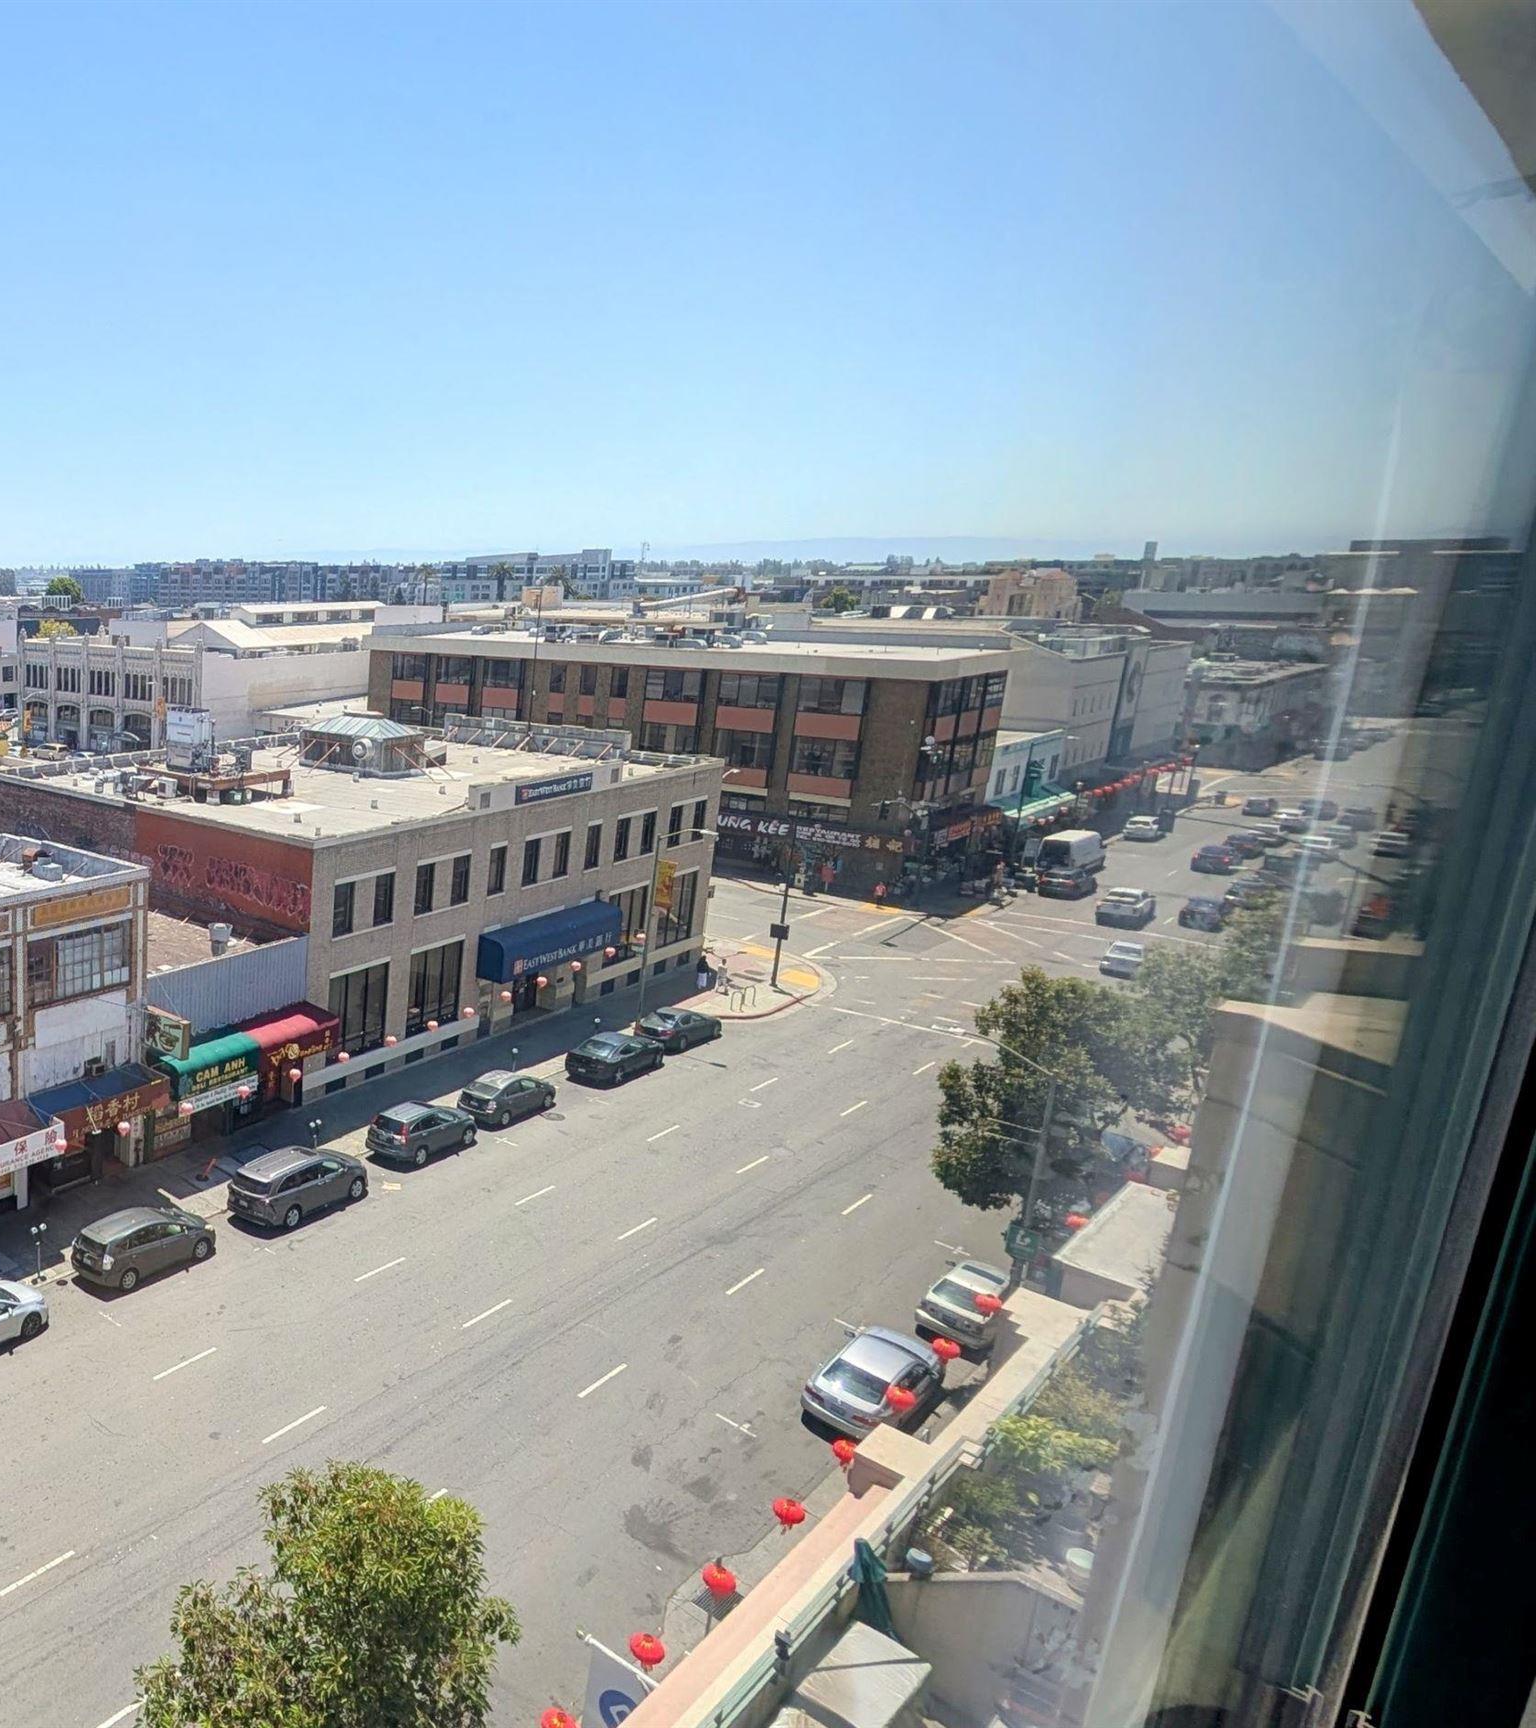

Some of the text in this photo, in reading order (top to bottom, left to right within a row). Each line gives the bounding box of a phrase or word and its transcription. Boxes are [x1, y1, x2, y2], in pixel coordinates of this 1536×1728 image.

[758, 820, 790, 836] KEE
[196, 1057, 245, 1082] CAM ANH
